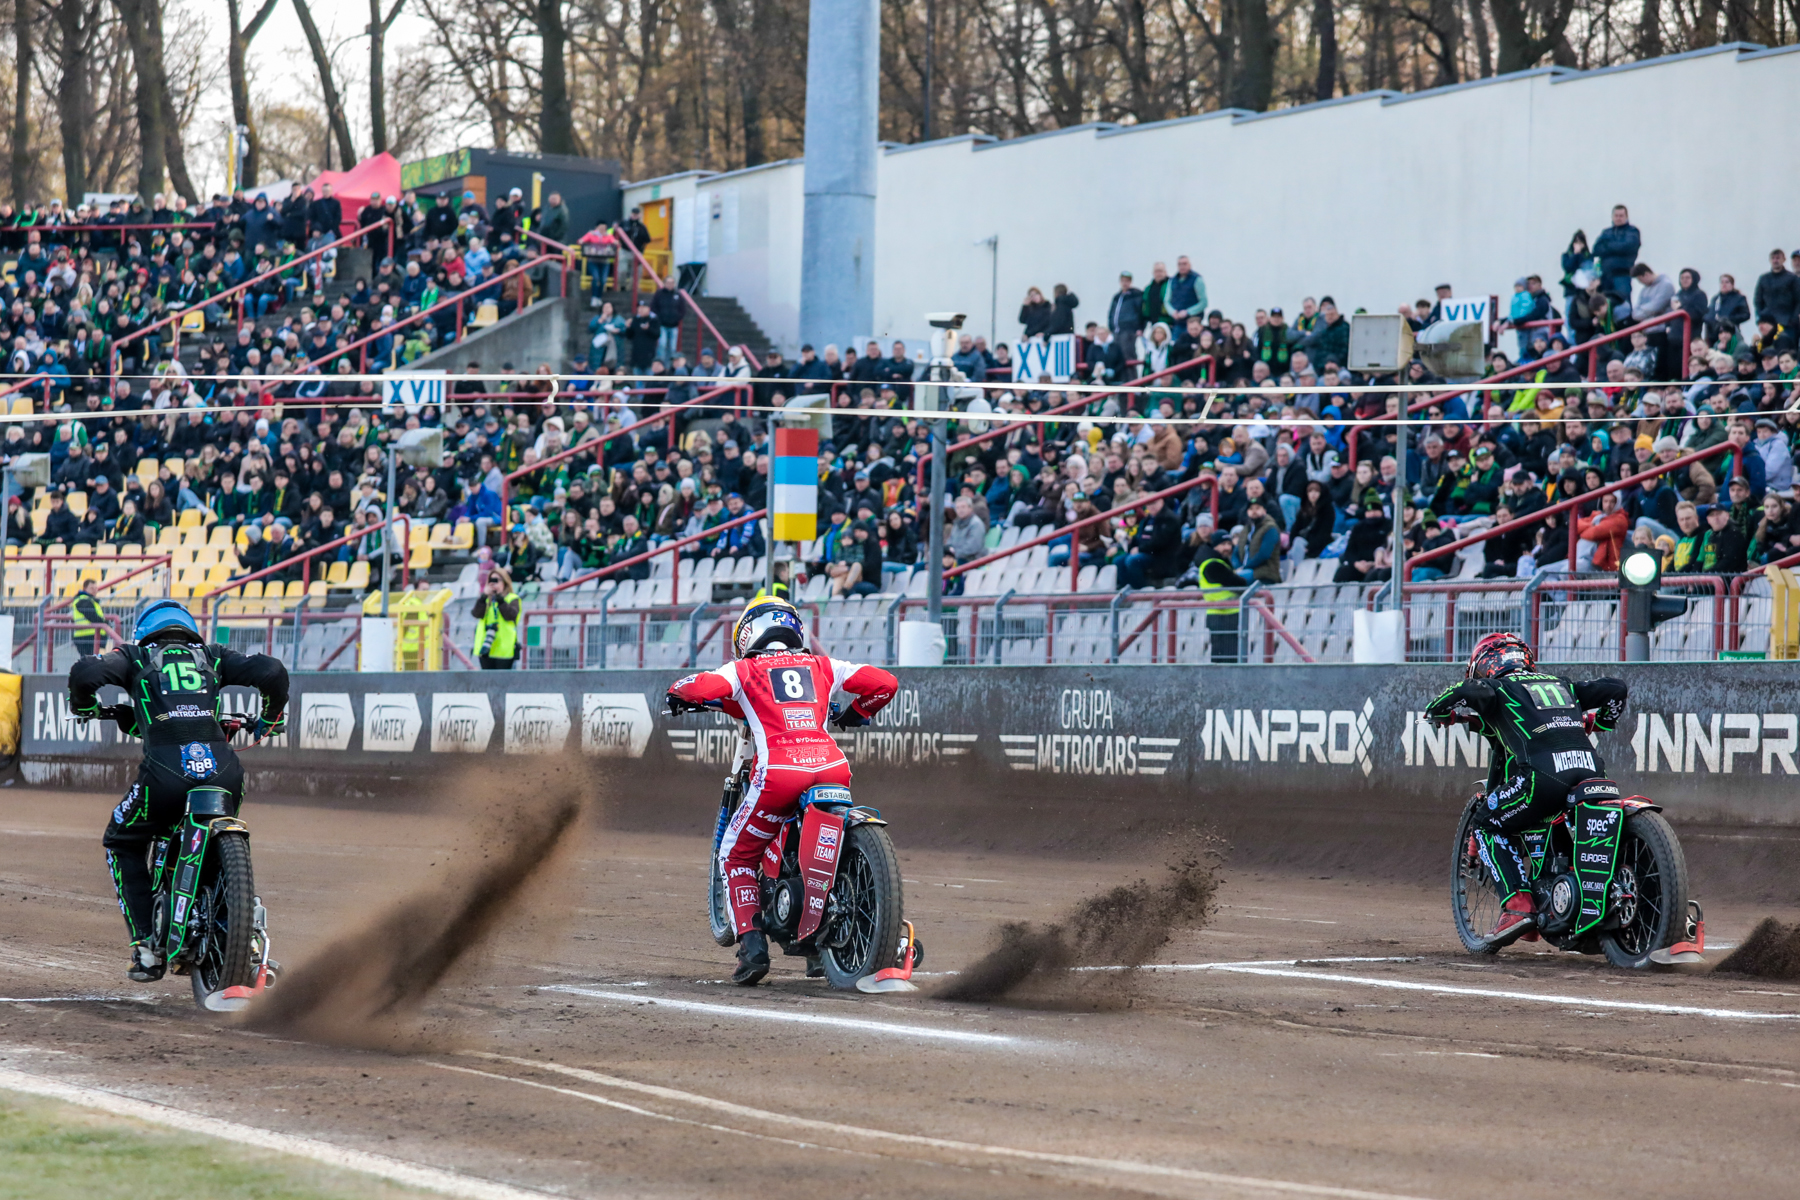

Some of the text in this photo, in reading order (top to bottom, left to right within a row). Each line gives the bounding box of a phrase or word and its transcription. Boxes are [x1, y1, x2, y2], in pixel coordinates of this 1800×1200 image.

[1017, 341, 1071, 379] XVIII
[388, 379, 442, 407] XVII
[162, 662, 202, 691] 15
[782, 670, 804, 698] 8
[1531, 684, 1566, 706] 11
[168, 710, 212, 718] METROCARS
[1061, 689, 1113, 729] GRUPA
[306, 718, 340, 740] MARTEX
[370, 719, 406, 741] MARTEX
[438, 719, 478, 742] MARTEX
[512, 721, 553, 744] MARTEX
[590, 721, 633, 747] MARTEX
[788, 720, 815, 728] TEAM
[1201, 709, 1358, 764] INNPRO
[1546, 721, 1583, 729] METROCARS
[696, 729, 740, 764] METRO
[856, 732, 941, 764] METROCARS
[1401, 711, 1490, 767] INN
[1630, 713, 1799, 775] INNPR
[1037, 734, 1137, 776] METROCARS
[1586, 818, 1609, 836] spec
[816, 845, 835, 860] TEAM
